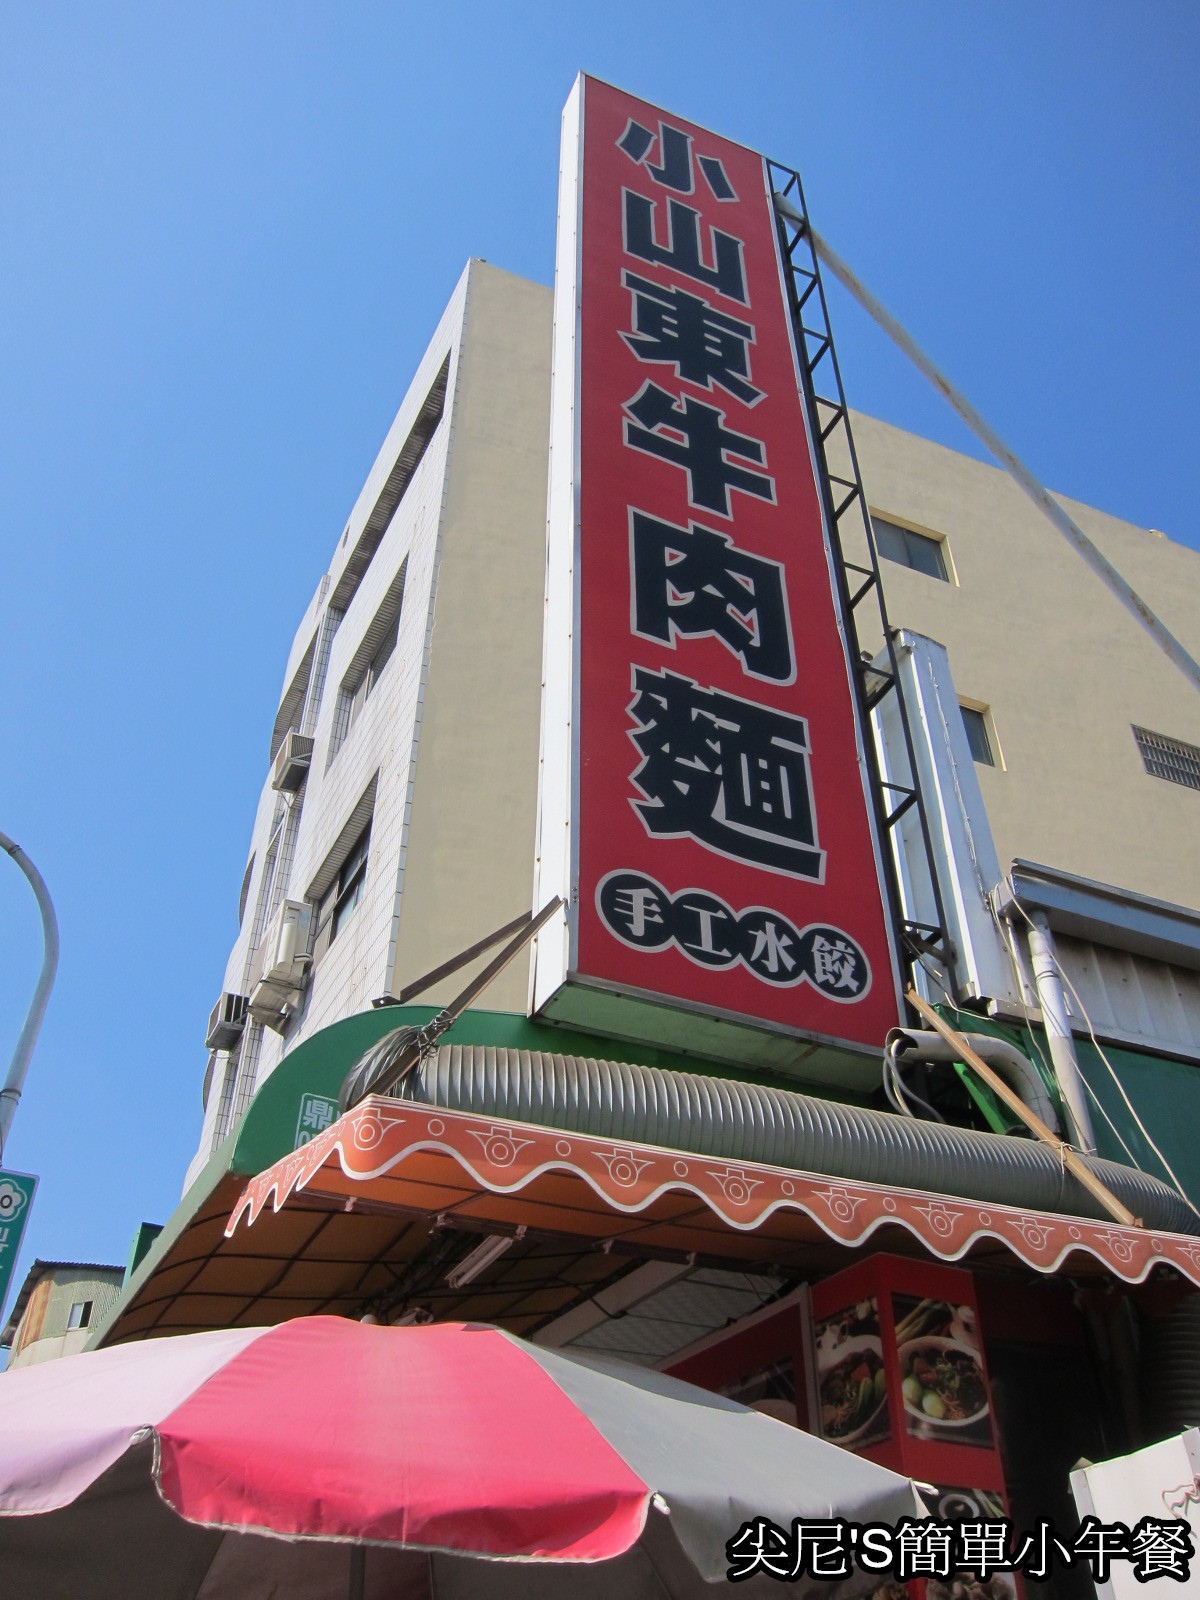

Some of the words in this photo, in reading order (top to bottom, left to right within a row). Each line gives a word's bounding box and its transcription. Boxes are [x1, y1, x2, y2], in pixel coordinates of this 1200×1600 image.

[615, 117, 827, 885] 小山東牛肉麵
[612, 887, 859, 993] 手工水餃
[303, 1099, 341, 1130] 鼎
